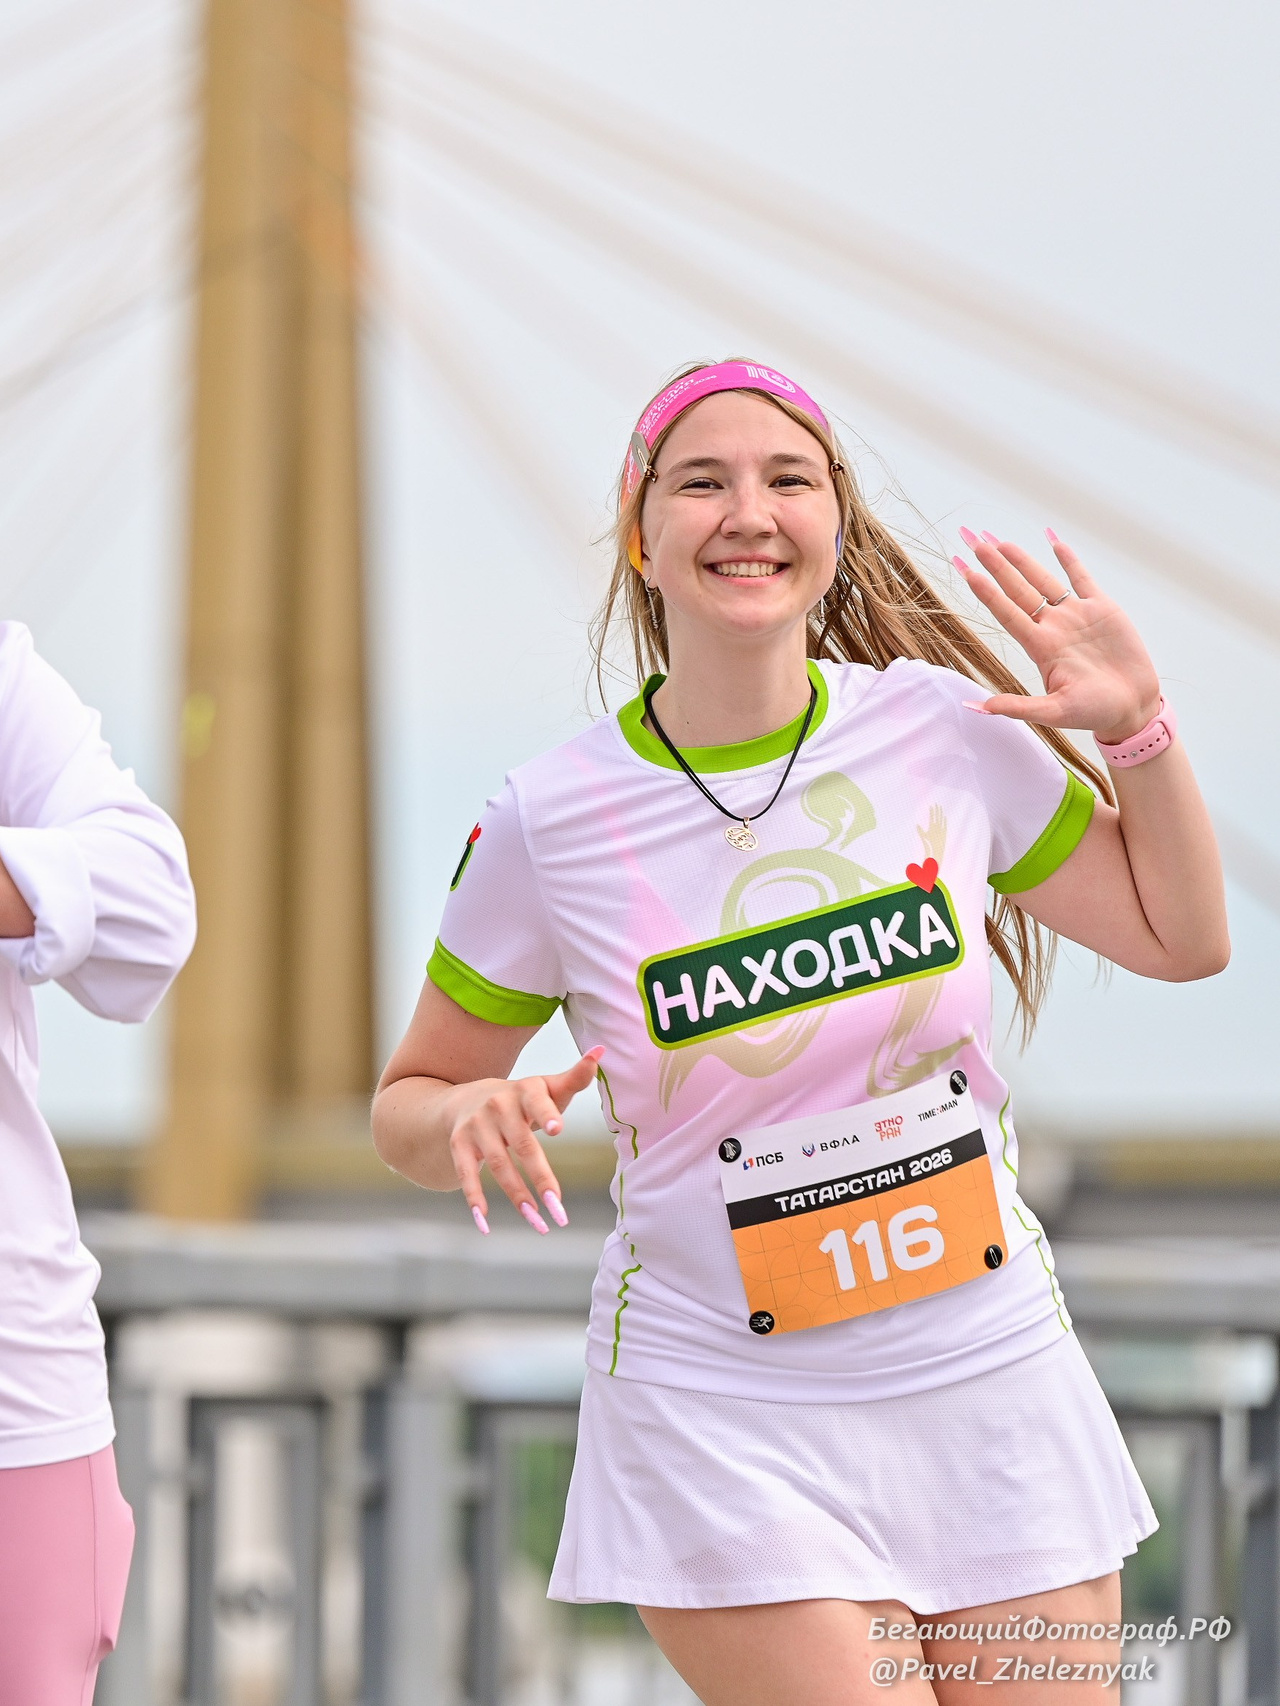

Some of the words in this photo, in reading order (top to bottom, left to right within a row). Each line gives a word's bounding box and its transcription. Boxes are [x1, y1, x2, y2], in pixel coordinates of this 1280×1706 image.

[653, 902, 957, 1031] НАХОДКА
[874, 1115, 904, 1132] ЭТНО
[819, 1134, 861, 1152] ВФЛА
[879, 1126, 901, 1142] РАН
[755, 1151, 784, 1168] ПСБ
[774, 1165, 906, 1213] ТАТАРСТАН
[908, 1147, 953, 1177] 2026
[818, 1204, 946, 1291] 116
